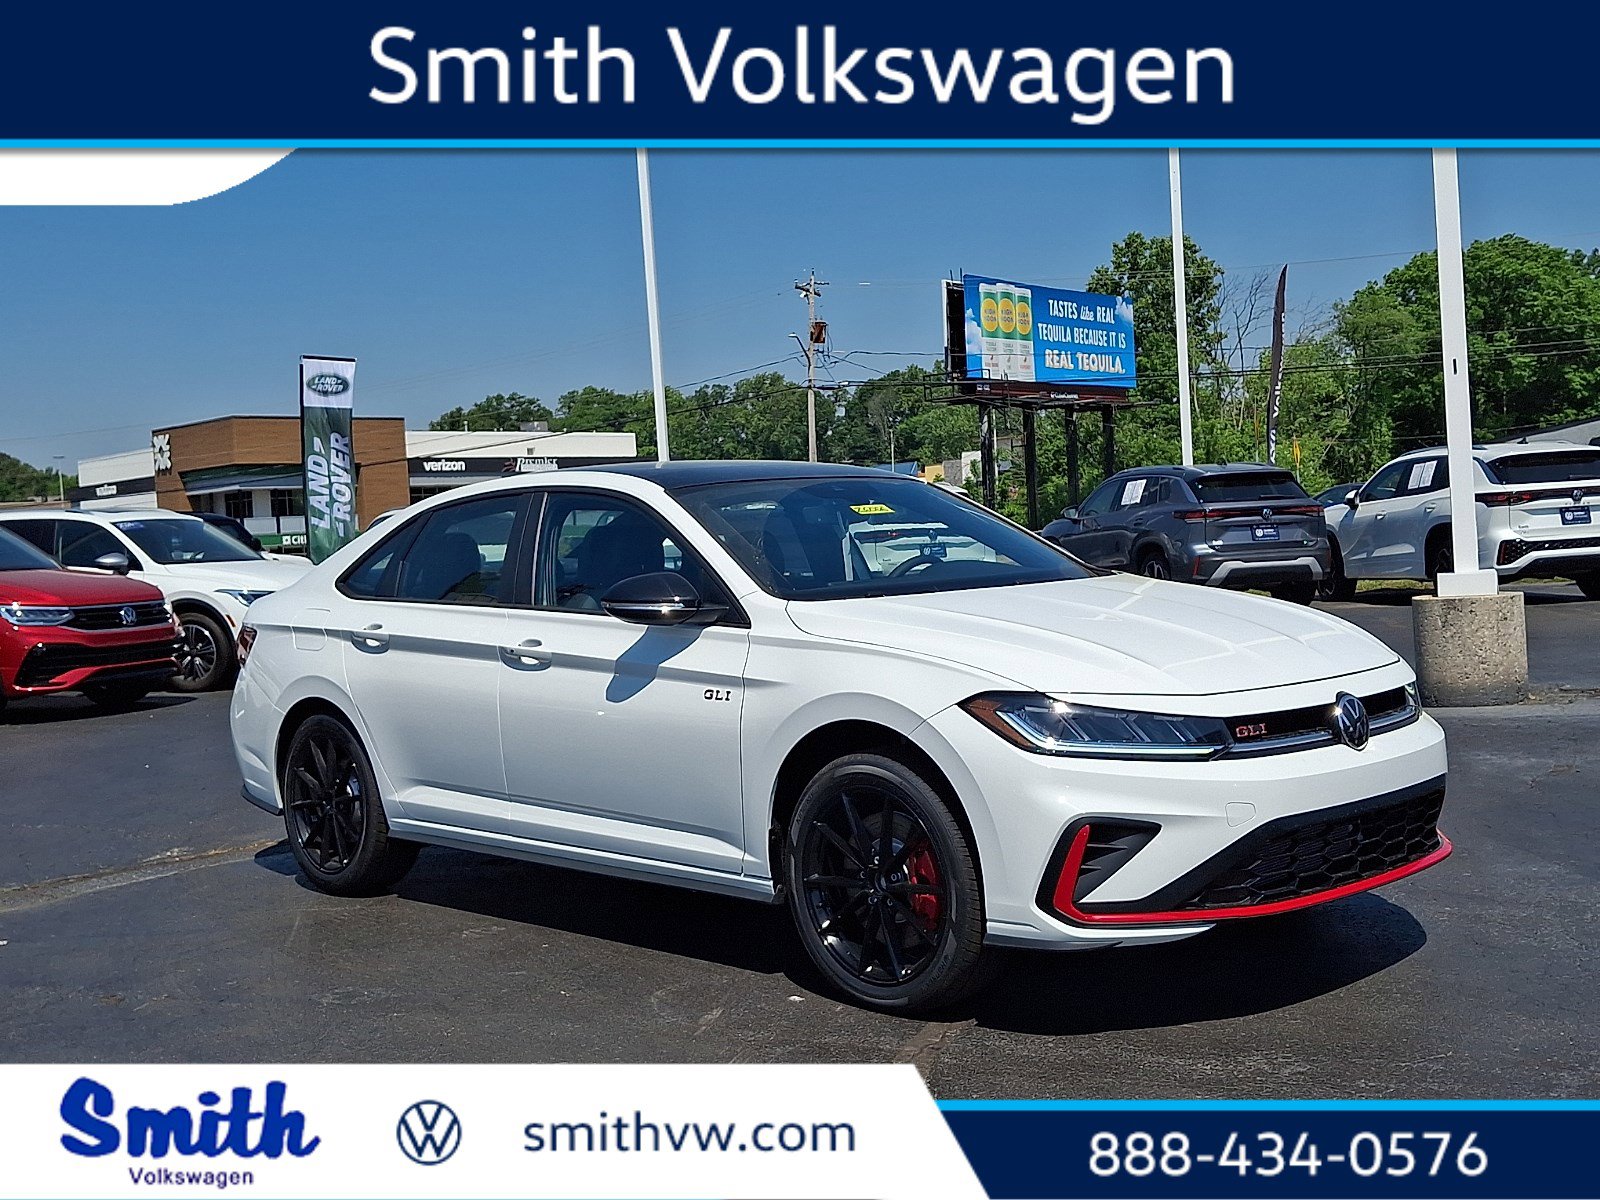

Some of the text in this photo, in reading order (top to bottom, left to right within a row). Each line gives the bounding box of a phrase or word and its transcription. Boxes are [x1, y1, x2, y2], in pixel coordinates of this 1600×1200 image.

[1048, 299, 1115, 324] TASTES like REAL
[1037, 322, 1126, 349] TEQUILA BECAUSE IT IS
[1045, 348, 1074, 369] REAL
[1076, 352, 1126, 374] TEQUILA.
[314, 376, 338, 385] LAND
[315, 384, 344, 393] ROVER
[423, 458, 466, 472] verizon
[330, 431, 351, 522] ROVER
[307, 454, 330, 530] LAND
[703, 688, 732, 702] GLI
[1235, 722, 1268, 738] GLI
